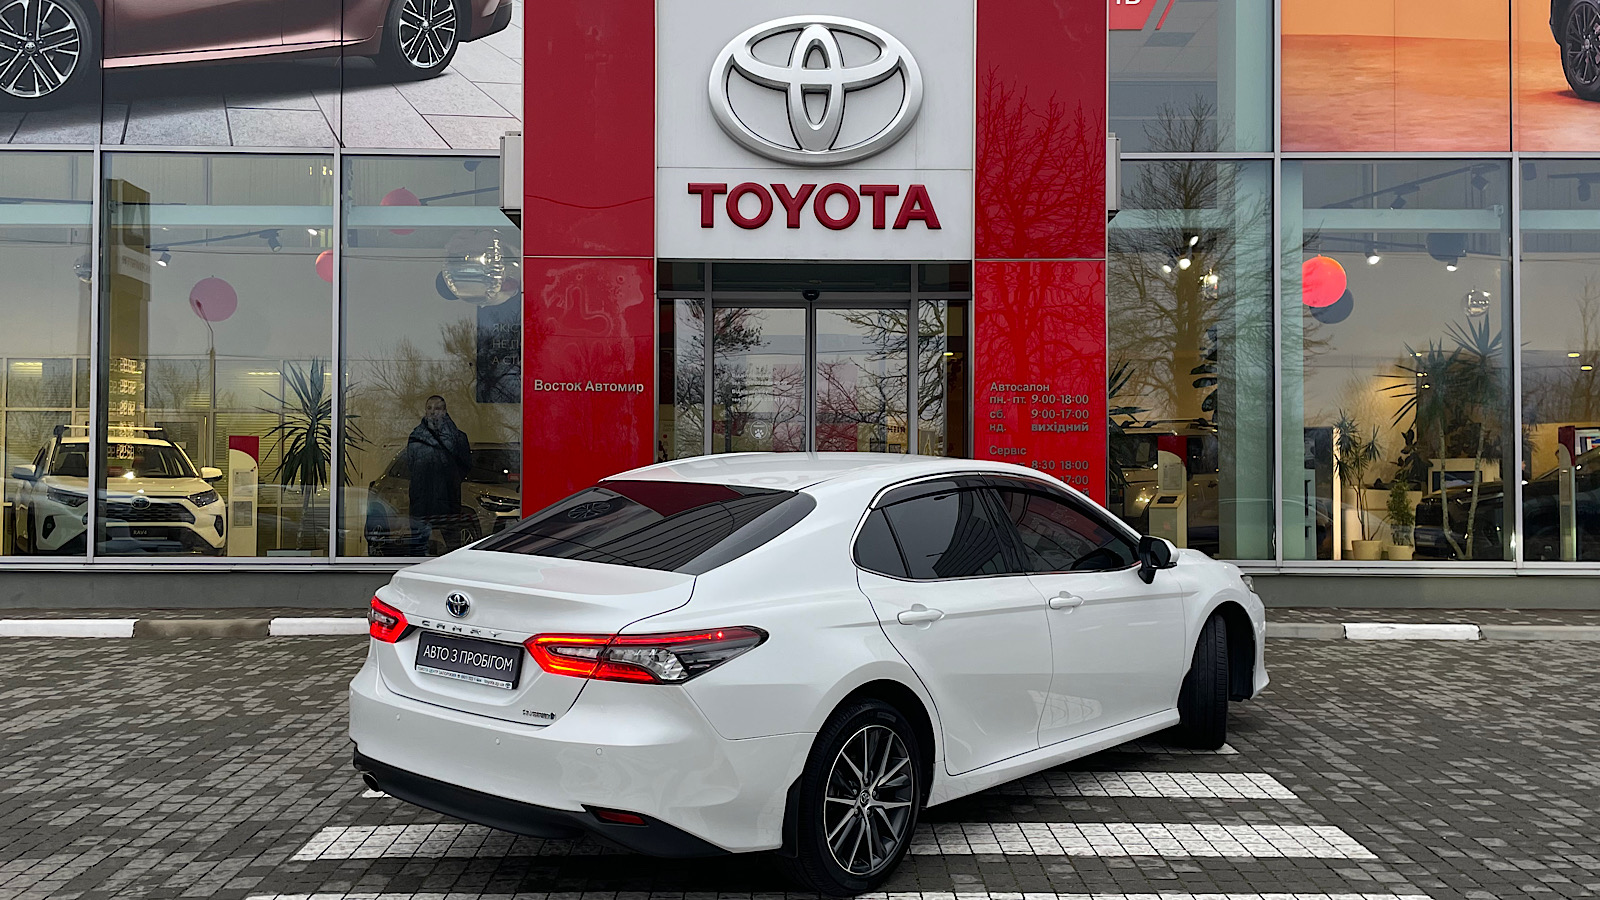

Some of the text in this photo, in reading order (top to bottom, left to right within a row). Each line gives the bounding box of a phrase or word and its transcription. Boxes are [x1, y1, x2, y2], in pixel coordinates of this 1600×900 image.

[687, 182, 942, 230] TOYOTA
[534, 379, 644, 394] Восток Автомир
[990, 382, 1050, 392] Автосалон
[989, 409, 1089, 419] сб. 9:00-17:00
[989, 421, 1089, 433] нд. вихідний
[989, 445, 1027, 457] Сервіс
[423, 644, 450, 661] АВТО
[459, 650, 513, 671] ПРОБІГОМ
